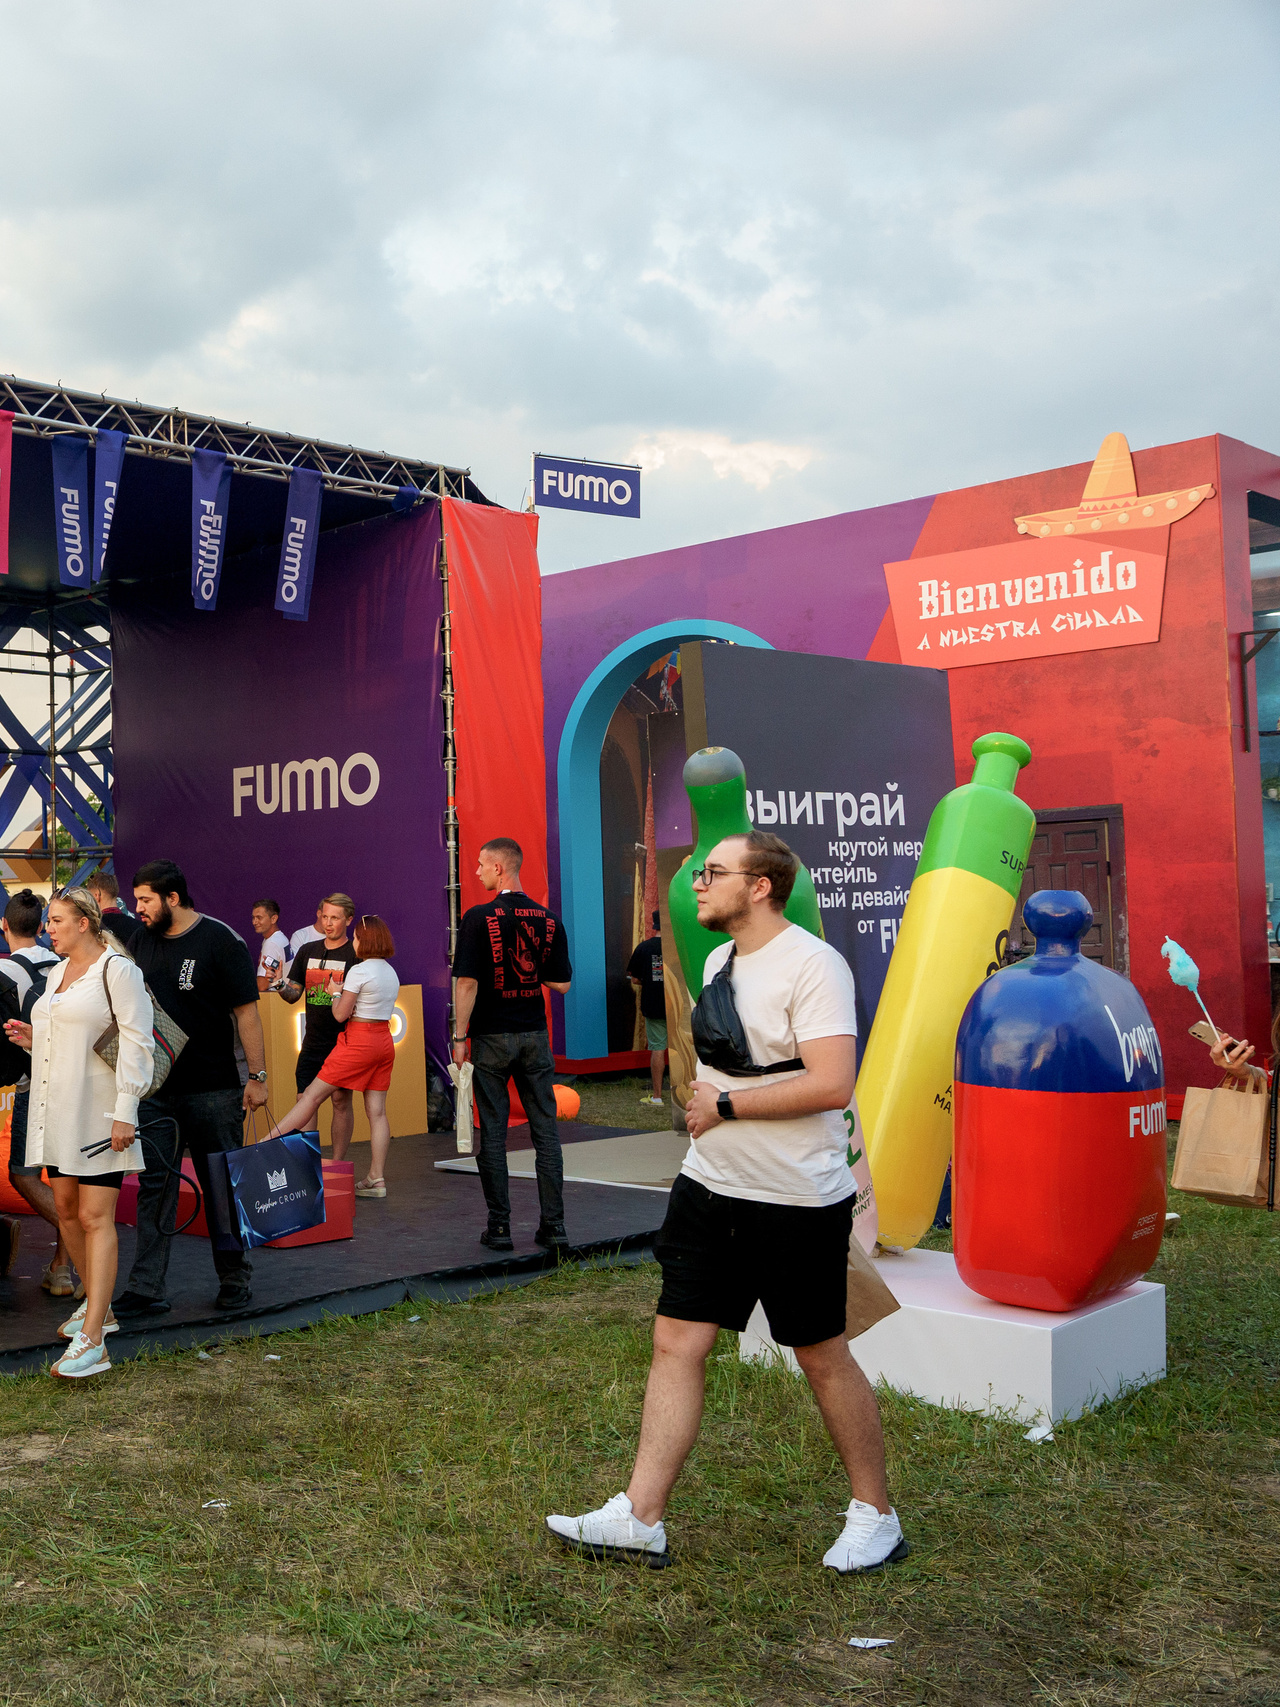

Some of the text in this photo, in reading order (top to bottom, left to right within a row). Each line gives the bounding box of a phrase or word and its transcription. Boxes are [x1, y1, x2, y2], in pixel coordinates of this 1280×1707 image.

[918, 551, 1136, 620] Bienvenido
[917, 634, 931, 651] A
[939, 618, 1041, 648] NUESTRA
[828, 837, 923, 861] крутой мер
[811, 862, 877, 884] ктейль
[1000, 850, 1025, 876] SUP
[514, 908, 546, 918] CENTURY
[857, 919, 875, 934] от
[486, 916, 503, 964] CENTURY
[934, 1094, 952, 1116] MA
[278, 1189, 307, 1205] CROWN
